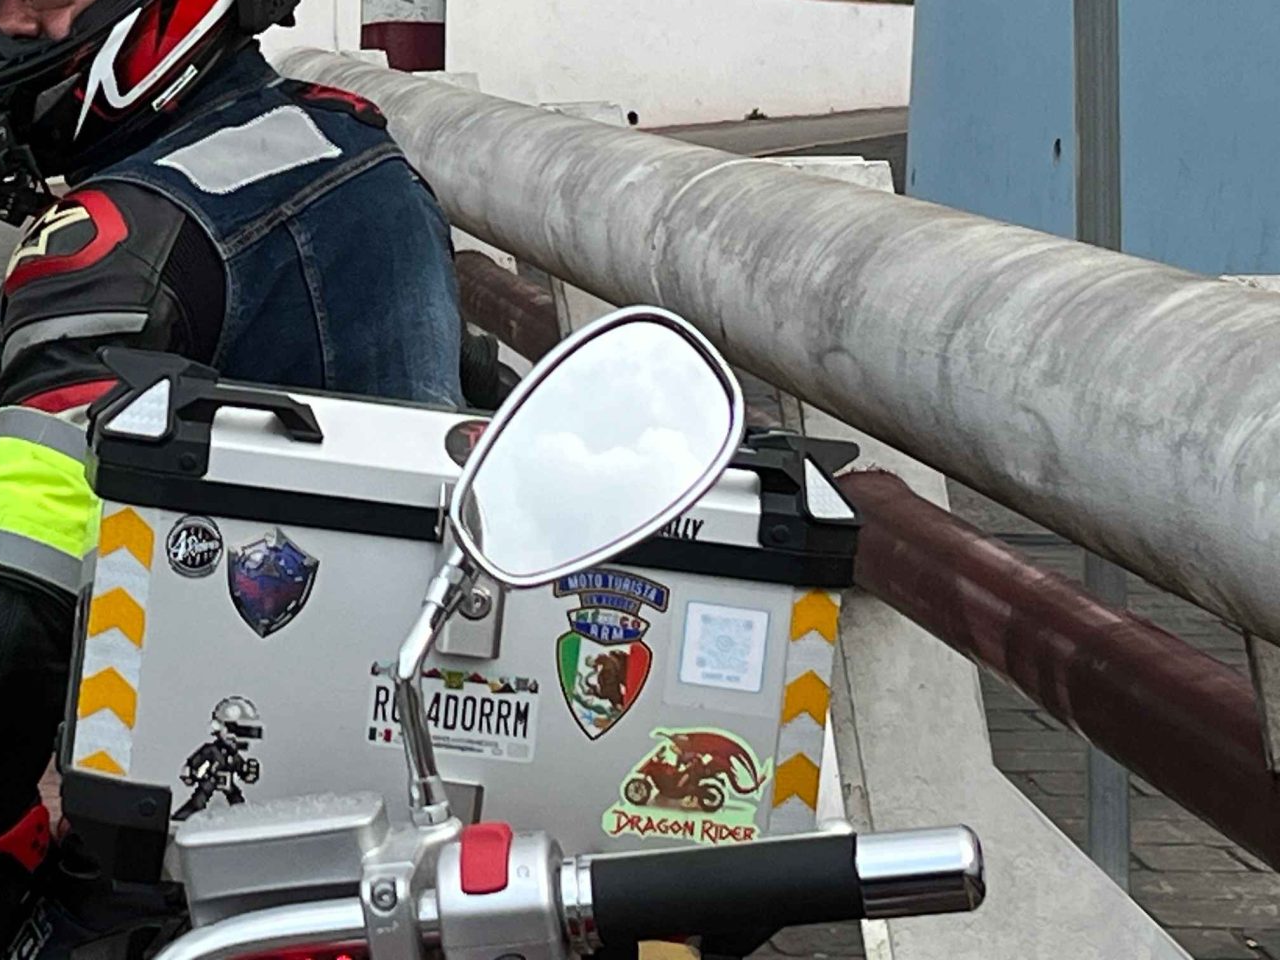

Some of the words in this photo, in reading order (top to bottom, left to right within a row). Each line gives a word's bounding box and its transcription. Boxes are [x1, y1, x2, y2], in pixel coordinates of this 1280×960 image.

[567, 573, 604, 590] MOTO
[607, 574, 658, 602] TURISTA
[373, 685, 530, 739] RADORRM
[610, 809, 696, 837] DRAGON
[700, 819, 756, 844] RIDER
